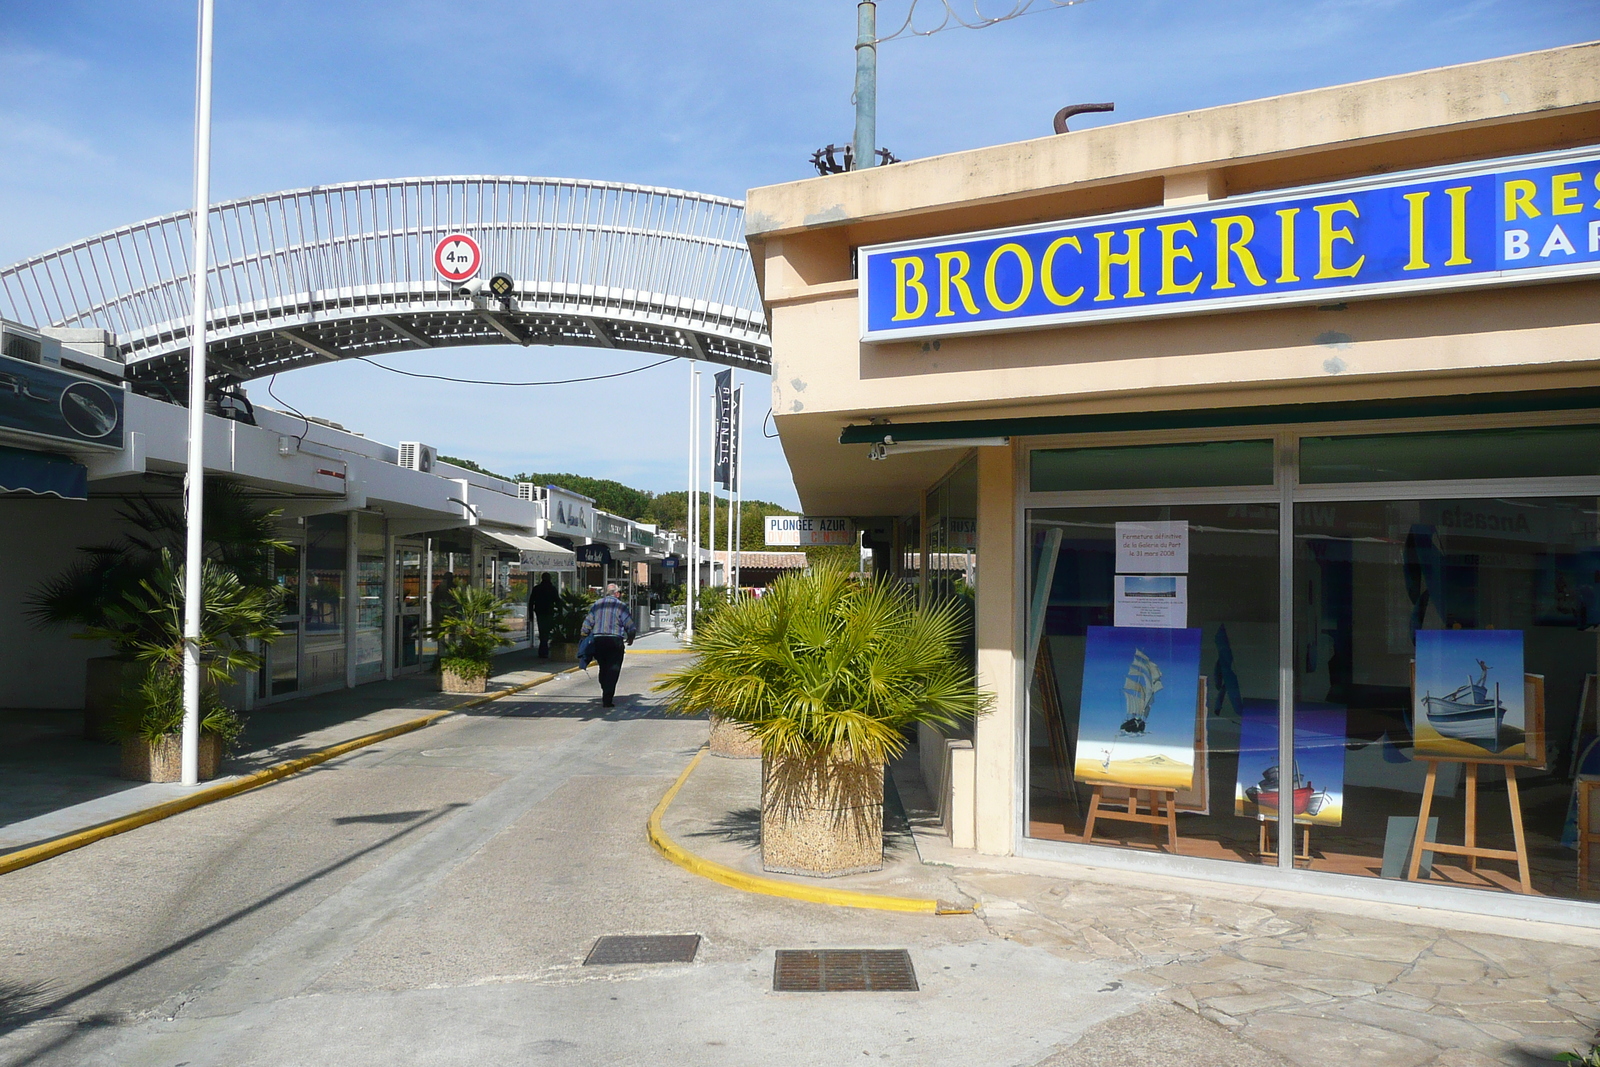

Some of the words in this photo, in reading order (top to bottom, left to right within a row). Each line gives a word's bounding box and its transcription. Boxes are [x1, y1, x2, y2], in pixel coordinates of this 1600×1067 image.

[1503, 170, 1600, 222] RE
[890, 199, 1366, 323] BROCHERIE
[1402, 185, 1473, 271] II
[720, 387, 730, 464] ATLANTIS
[770, 519, 813, 531] PLONGEE
[819, 519, 846, 531] AZUR
[1131, 541, 1138, 549] la
[1138, 541, 1159, 549] Galerie
